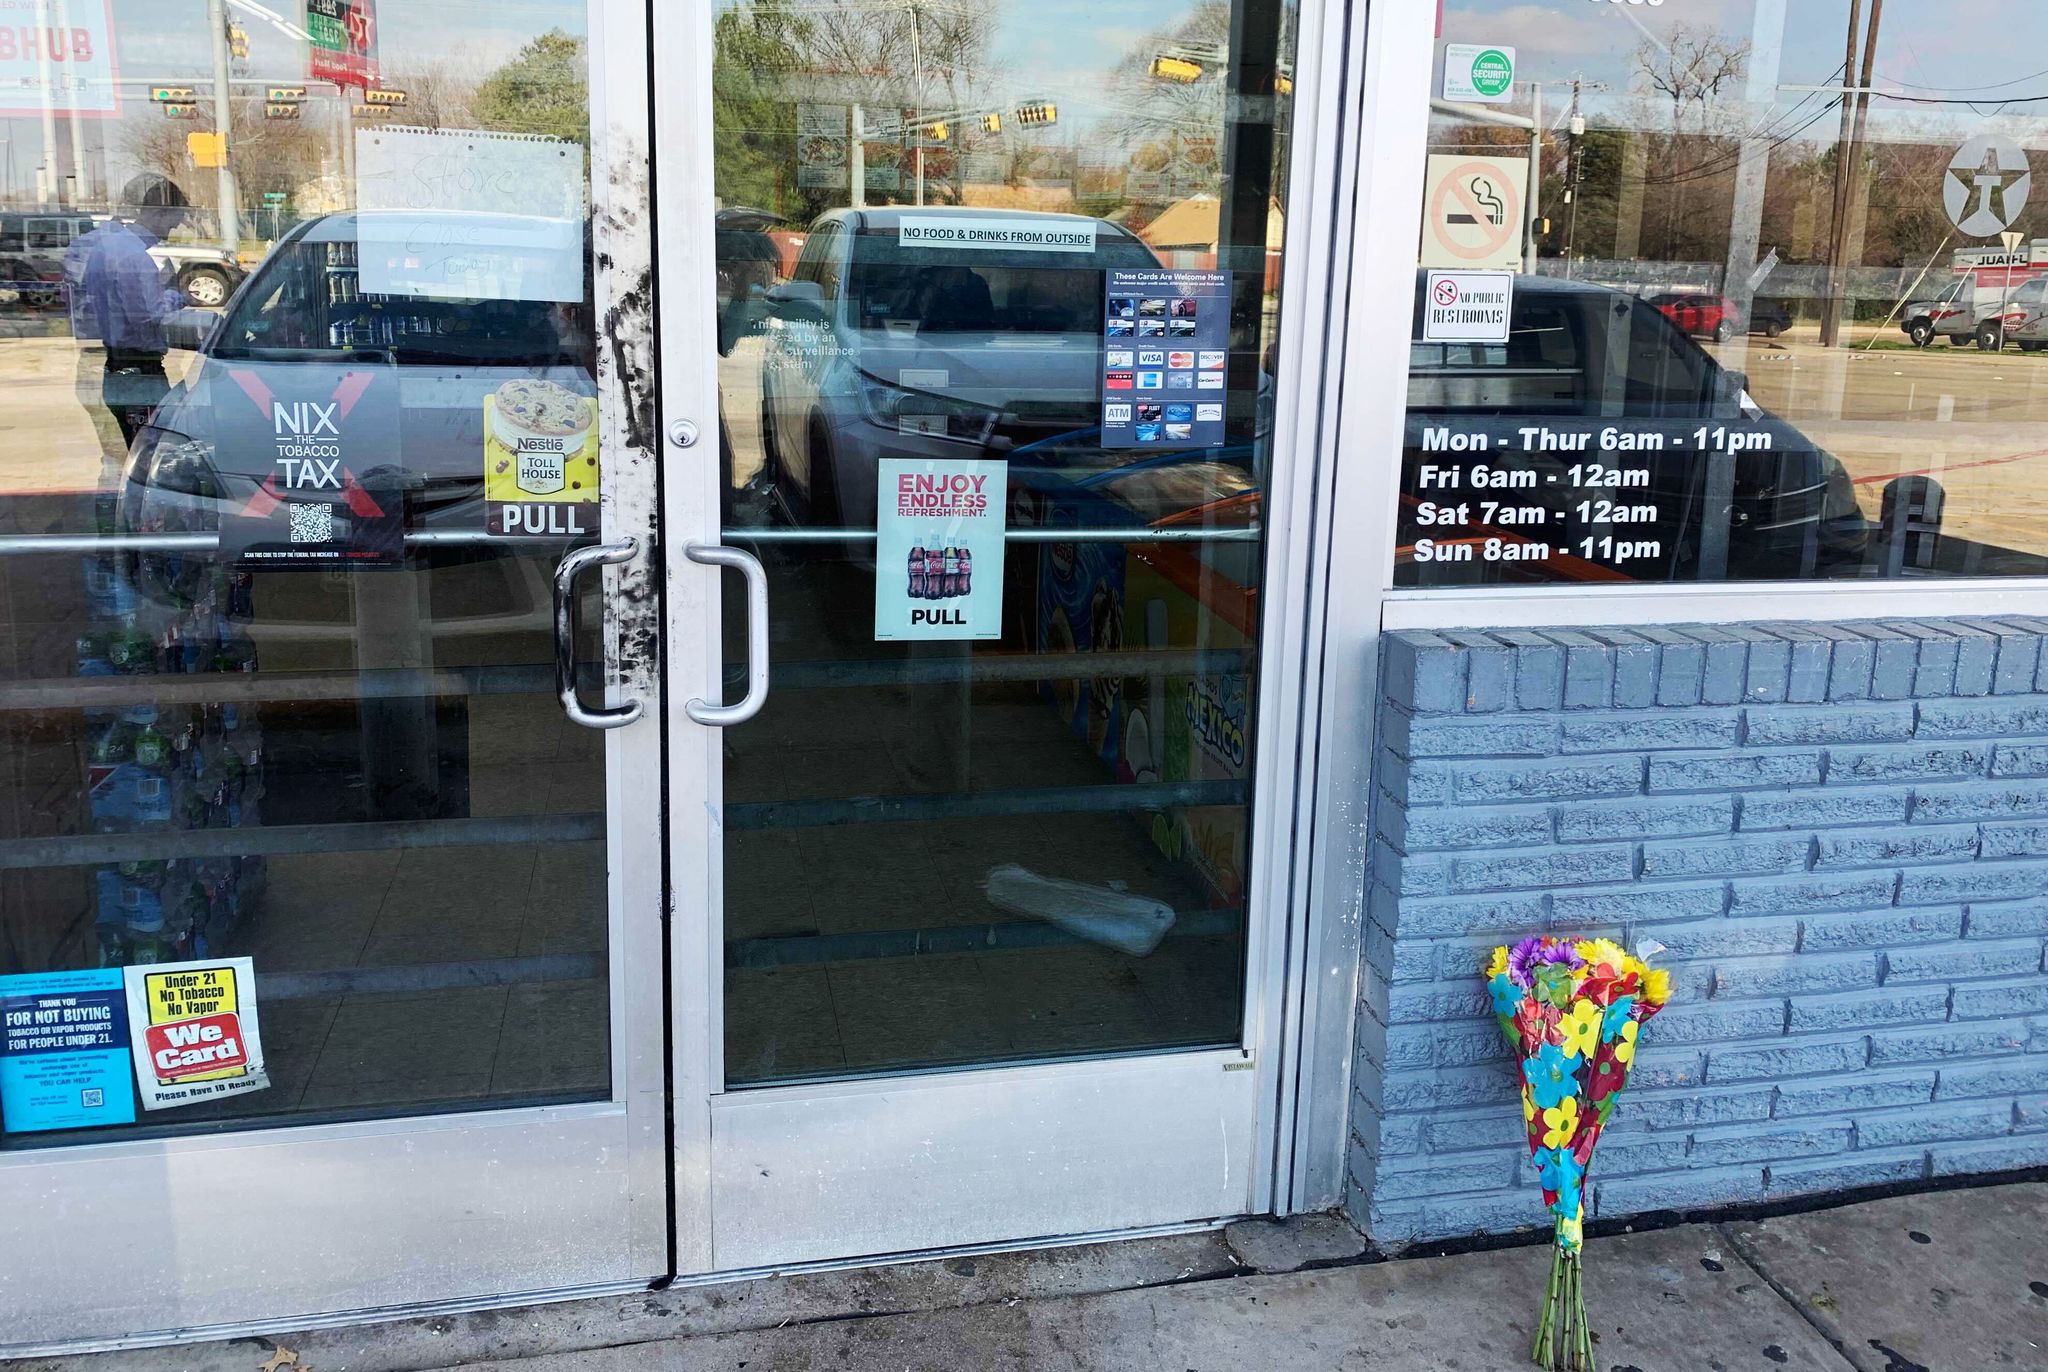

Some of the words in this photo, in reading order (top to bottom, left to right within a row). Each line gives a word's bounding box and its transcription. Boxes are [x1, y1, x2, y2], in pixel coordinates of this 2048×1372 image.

[1480, 62, 1505, 70] CENTRAL
[1472, 69, 1511, 80] SECURITY
[904, 227, 921, 238] NO
[924, 228, 954, 239] FOOD
[957, 229, 966, 240] &
[969, 230, 1008, 241] DRINKS
[1011, 231, 1043, 243] FROM
[1045, 233, 1091, 244] OUTSIDE
[1115, 272, 1137, 280] These
[1174, 273, 1206, 281] Welcome
[1207, 273, 1225, 281] Here
[1459, 292, 1471, 304] NO
[1472, 292, 1504, 304] PUBLIC
[1433, 309, 1503, 324] RESTROOMS
[804, 333, 819, 345] by
[1141, 354, 1162, 362] VISA
[274, 402, 340, 435] NIX
[1107, 408, 1129, 418] ATM
[294, 434, 316, 445] THE
[1422, 427, 1488, 451] Mon
[1518, 427, 1591, 451] Thur
[1600, 427, 1664, 450] 6am
[1693, 427, 1772, 455] 11pm
[276, 445, 340, 457] TOBACCO
[527, 457, 556, 468] TOLL
[276, 458, 342, 489] TAX
[521, 468, 561, 479] HOUSE
[1419, 465, 1460, 488] Fri
[1470, 465, 1537, 488] 6am
[1567, 464, 1650, 488] 12am
[898, 474, 988, 493] ENJOY
[898, 493, 987, 508] ENDLESS
[502, 504, 585, 534] PULL
[897, 508, 987, 517] REFRESHMENT.
[1416, 502, 1469, 525] Sat
[1480, 501, 1546, 525] 7am
[1576, 500, 1658, 524] 12am
[1413, 538, 1473, 562] Sun
[1483, 537, 1549, 561] 8am
[1579, 536, 1661, 564] 11pm
[911, 609, 967, 625] PULL
[1186, 681, 1244, 768] MEXICO
[164, 975, 199, 989] Under
[203, 972, 216, 985] 21
[160, 990, 175, 1003] No
[178, 986, 224, 1001] Tobacco
[38, 1000, 61, 1008] THANK
[61, 998, 77, 1006] YOU
[167, 1003, 182, 1016] No
[186, 1000, 219, 1015] Vapor
[6, 1012, 31, 1027] FOR
[35, 1009, 60, 1024] NOT
[63, 1006, 111, 1022] BUYING
[8, 1027, 40, 1037] TOBACCO
[40, 1026, 51, 1035] OR
[51, 1025, 74, 1034] VAPOR
[75, 1022, 112, 1032] PRODUCTS
[163, 1023, 223, 1048] We
[8, 1039, 27, 1050] FOR
[29, 1036, 65, 1049] PEOPLE
[65, 1034, 96, 1046] UNDER
[98, 1033, 113, 1044] 21.
[155, 1037, 240, 1070] Card
[155, 1090, 187, 1102] Please
[189, 1086, 213, 1097] Have
[215, 1084, 226, 1092] ID
[229, 1078, 257, 1090] Ready
